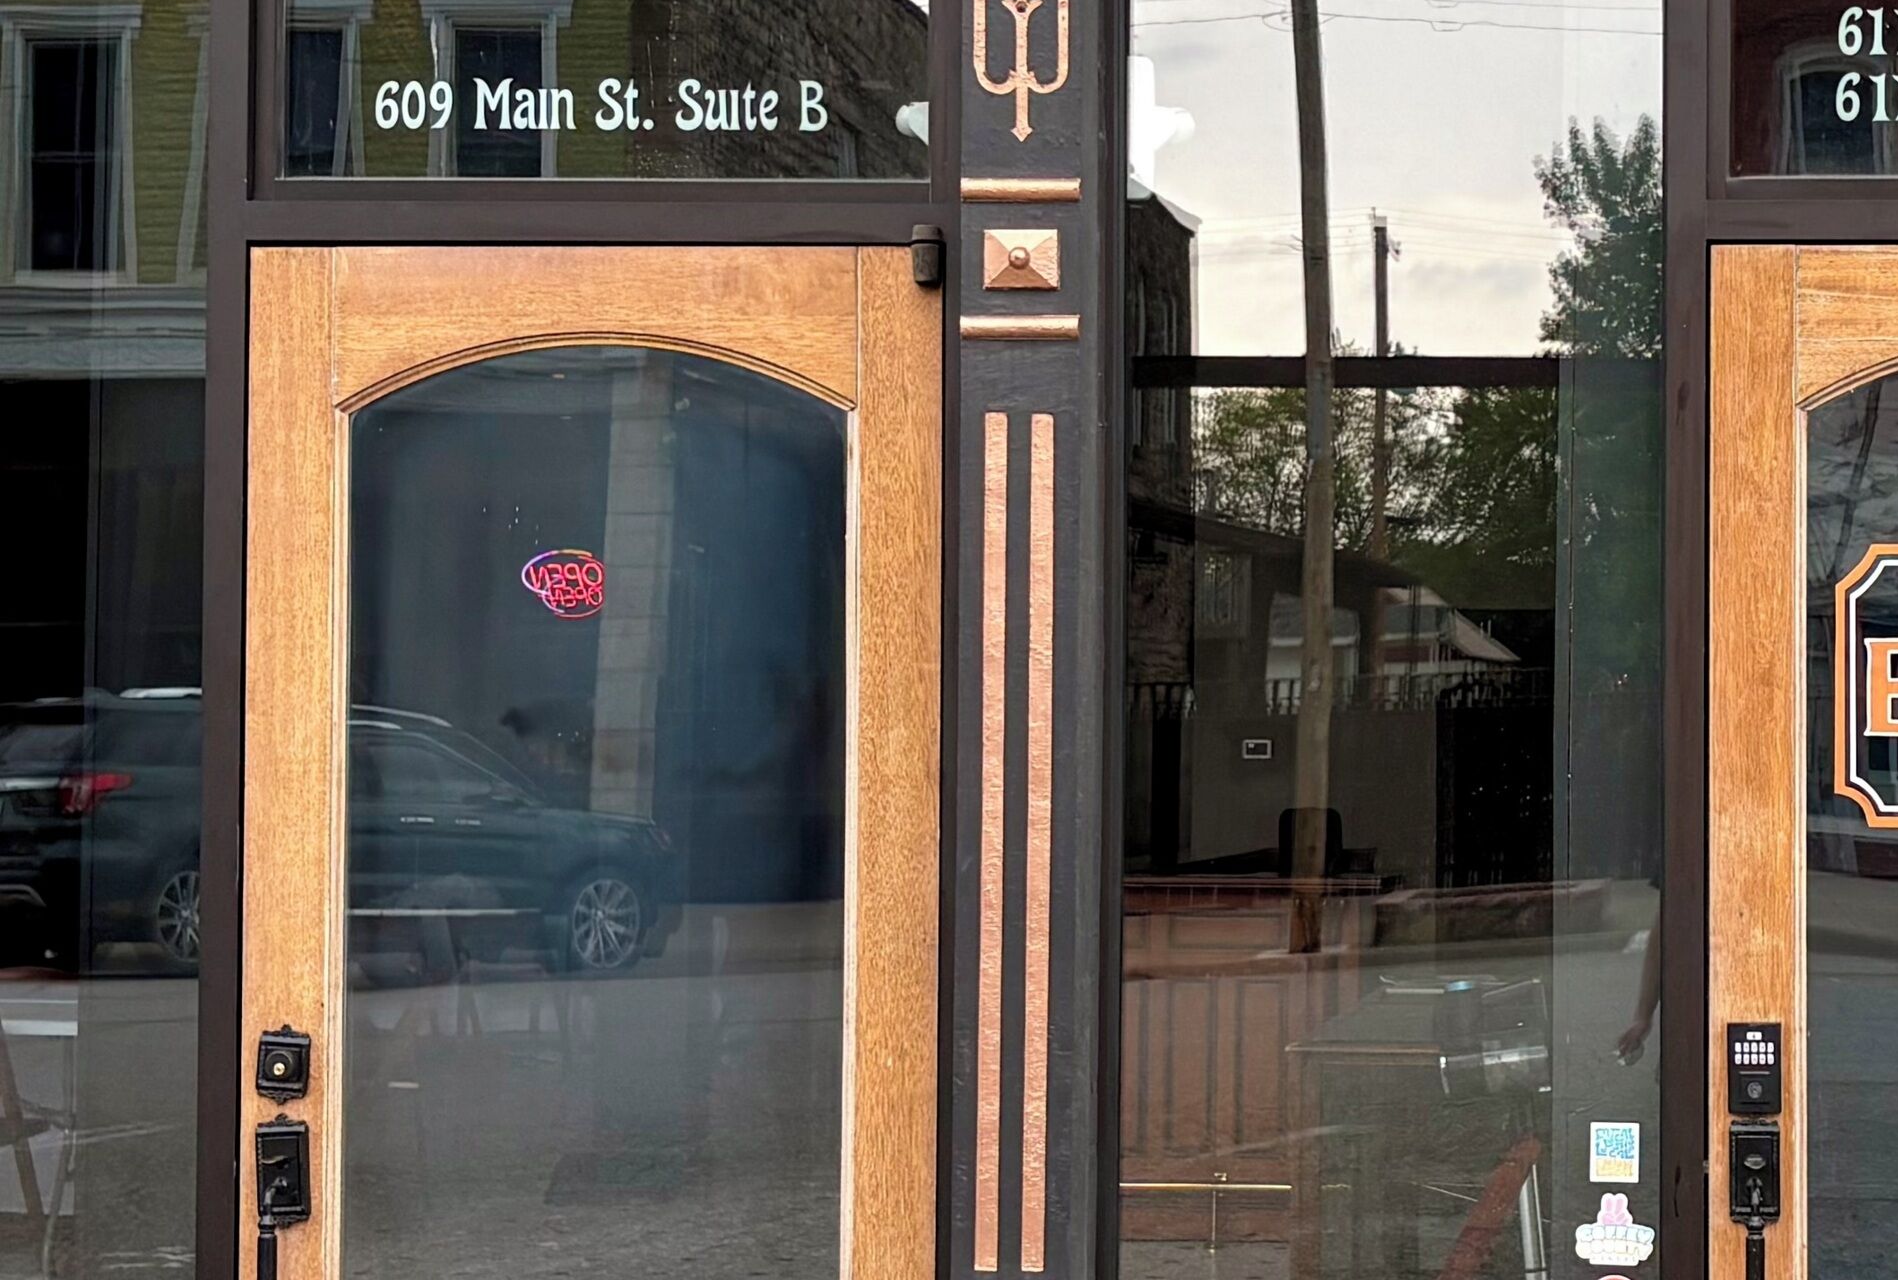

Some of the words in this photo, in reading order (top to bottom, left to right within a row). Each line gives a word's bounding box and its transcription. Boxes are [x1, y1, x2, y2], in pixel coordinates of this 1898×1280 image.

[375, 80, 453, 129] 609
[473, 77, 576, 130] Main
[595, 78, 654, 131] St.
[675, 78, 779, 131] Suite
[799, 80, 828, 132] B
